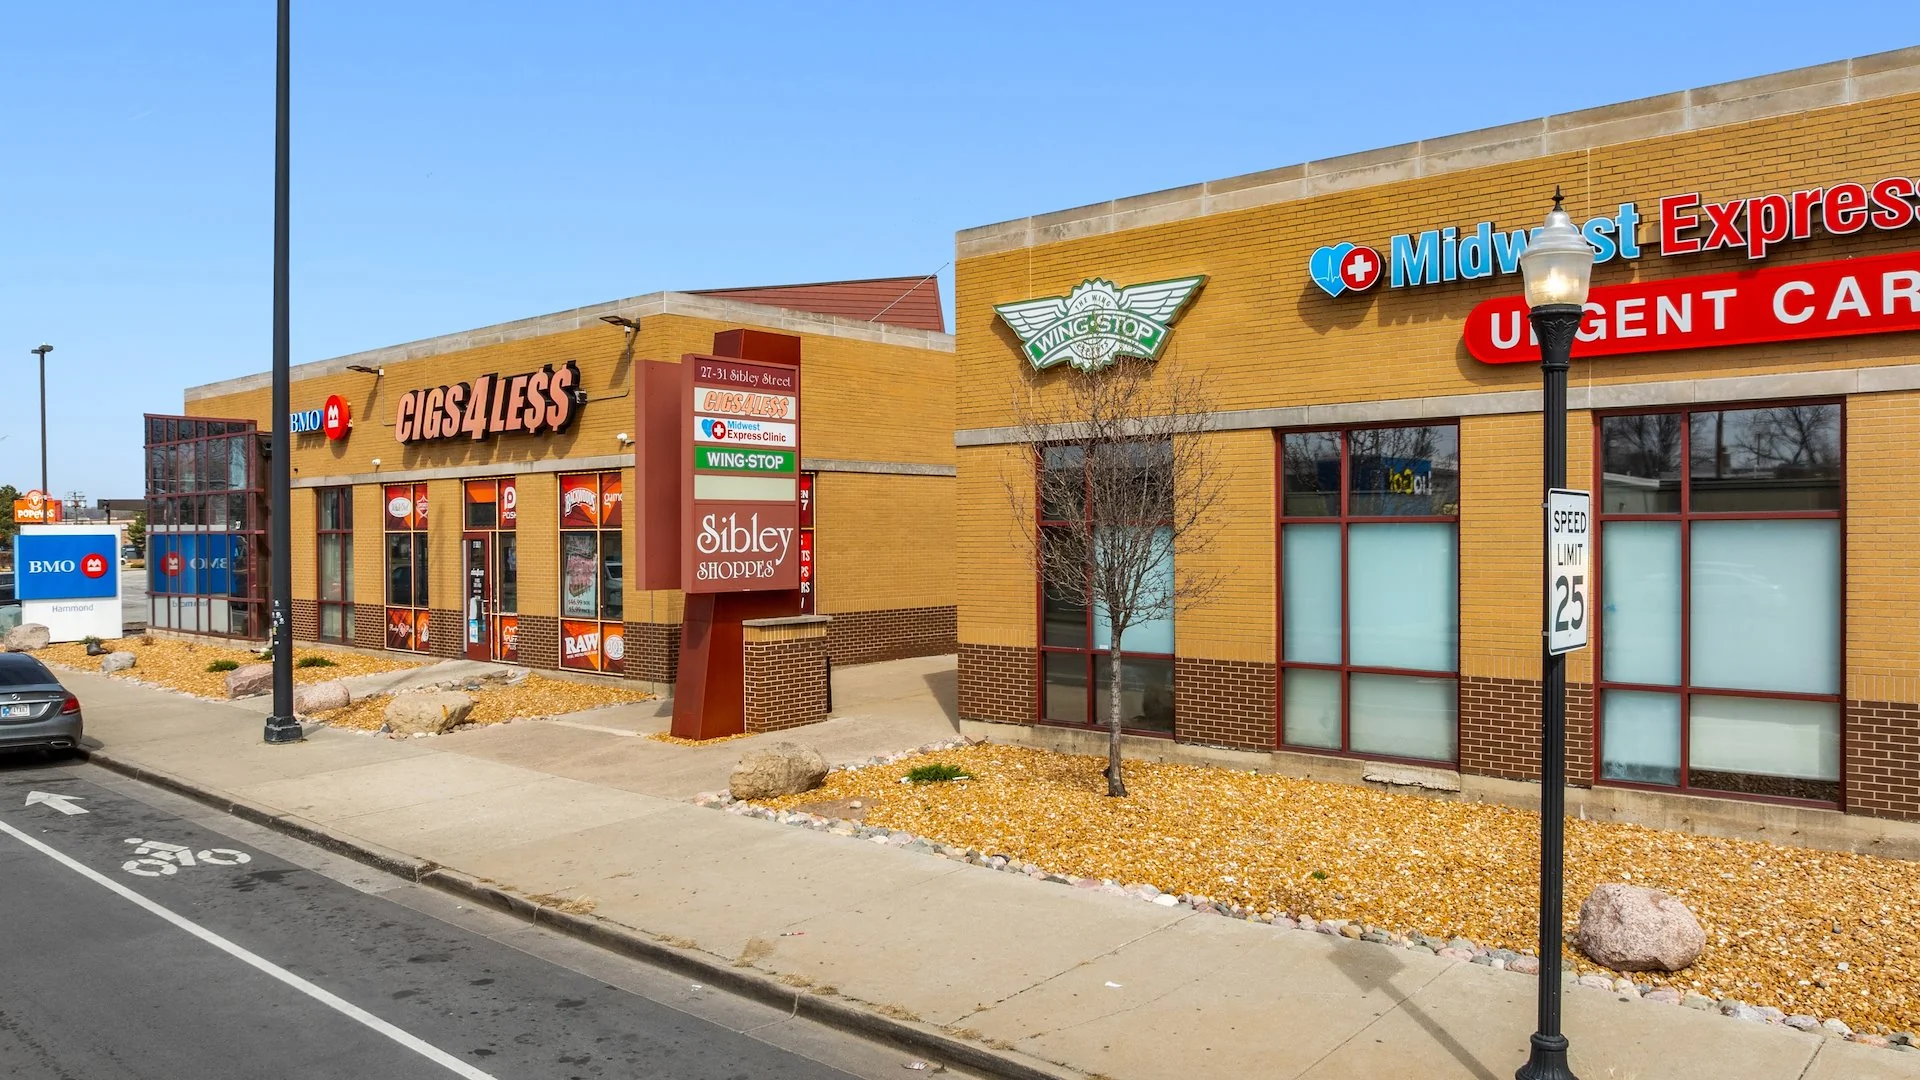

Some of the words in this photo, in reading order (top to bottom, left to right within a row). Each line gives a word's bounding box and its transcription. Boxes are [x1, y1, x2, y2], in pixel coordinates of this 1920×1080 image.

[1391, 203, 1640, 288] Midwst
[1660, 177, 1920, 260] Expres
[1075, 297, 1088, 311] THE
[1092, 294, 1111, 307] WING
[1491, 289, 1737, 350] UGENT
[700, 366, 727, 380] 27-31
[729, 369, 759, 387] Sibley
[762, 373, 791, 387] Street
[290, 410, 320, 432] BMO
[727, 421, 760, 431] Midwest
[727, 430, 761, 441] Express
[763, 432, 787, 442] Clinic
[17, 509, 55, 519] POPEYS
[1554, 510, 1587, 534] SPEED
[697, 512, 794, 566] Sibley
[1558, 543, 1583, 566] LIMIT
[28, 560, 75, 573] BMO
[697, 560, 774, 580] SHOPPES
[52, 604, 94, 612] Hammond
[1555, 575, 1584, 632] 25
[565, 633, 599, 655] RAW
